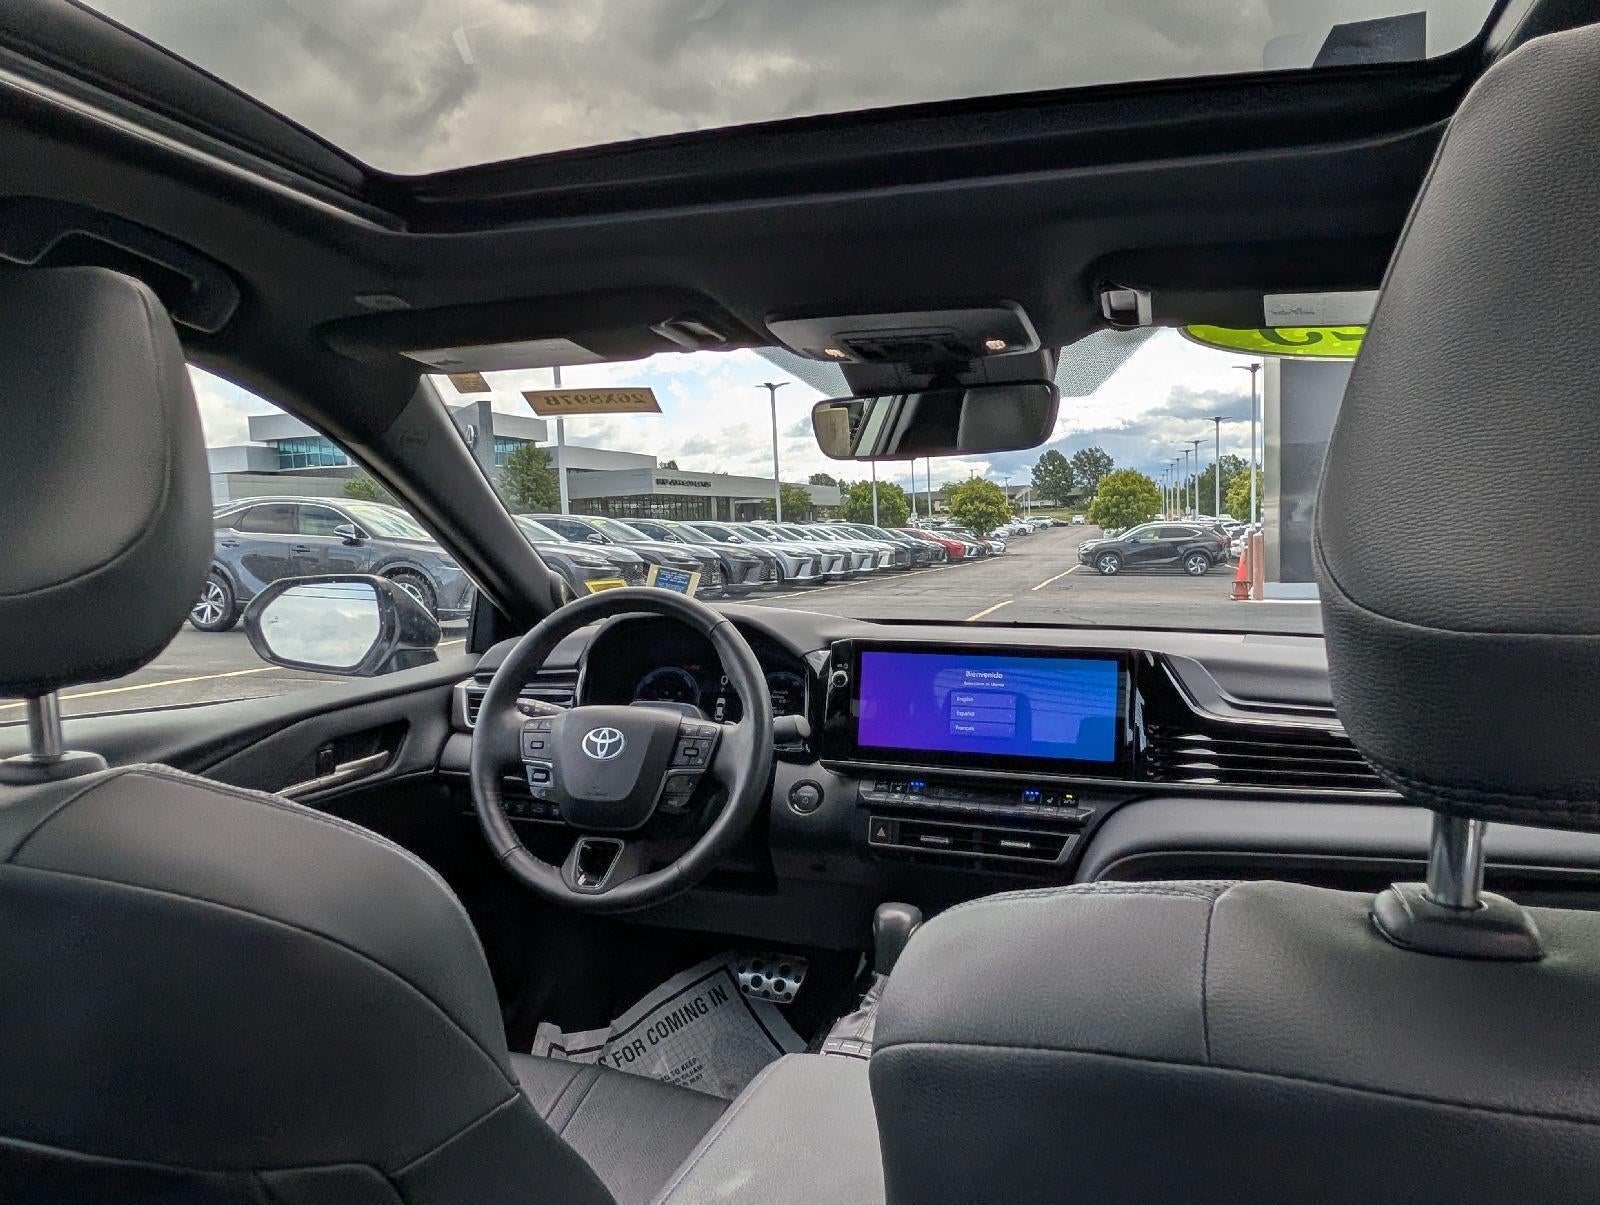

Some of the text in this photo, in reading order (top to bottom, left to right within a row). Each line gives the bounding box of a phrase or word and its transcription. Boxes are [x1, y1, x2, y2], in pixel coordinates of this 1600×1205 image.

[611, 1038, 646, 1068] FOR
[646, 997, 710, 1046] COMING
[708, 984, 729, 1008] IN
